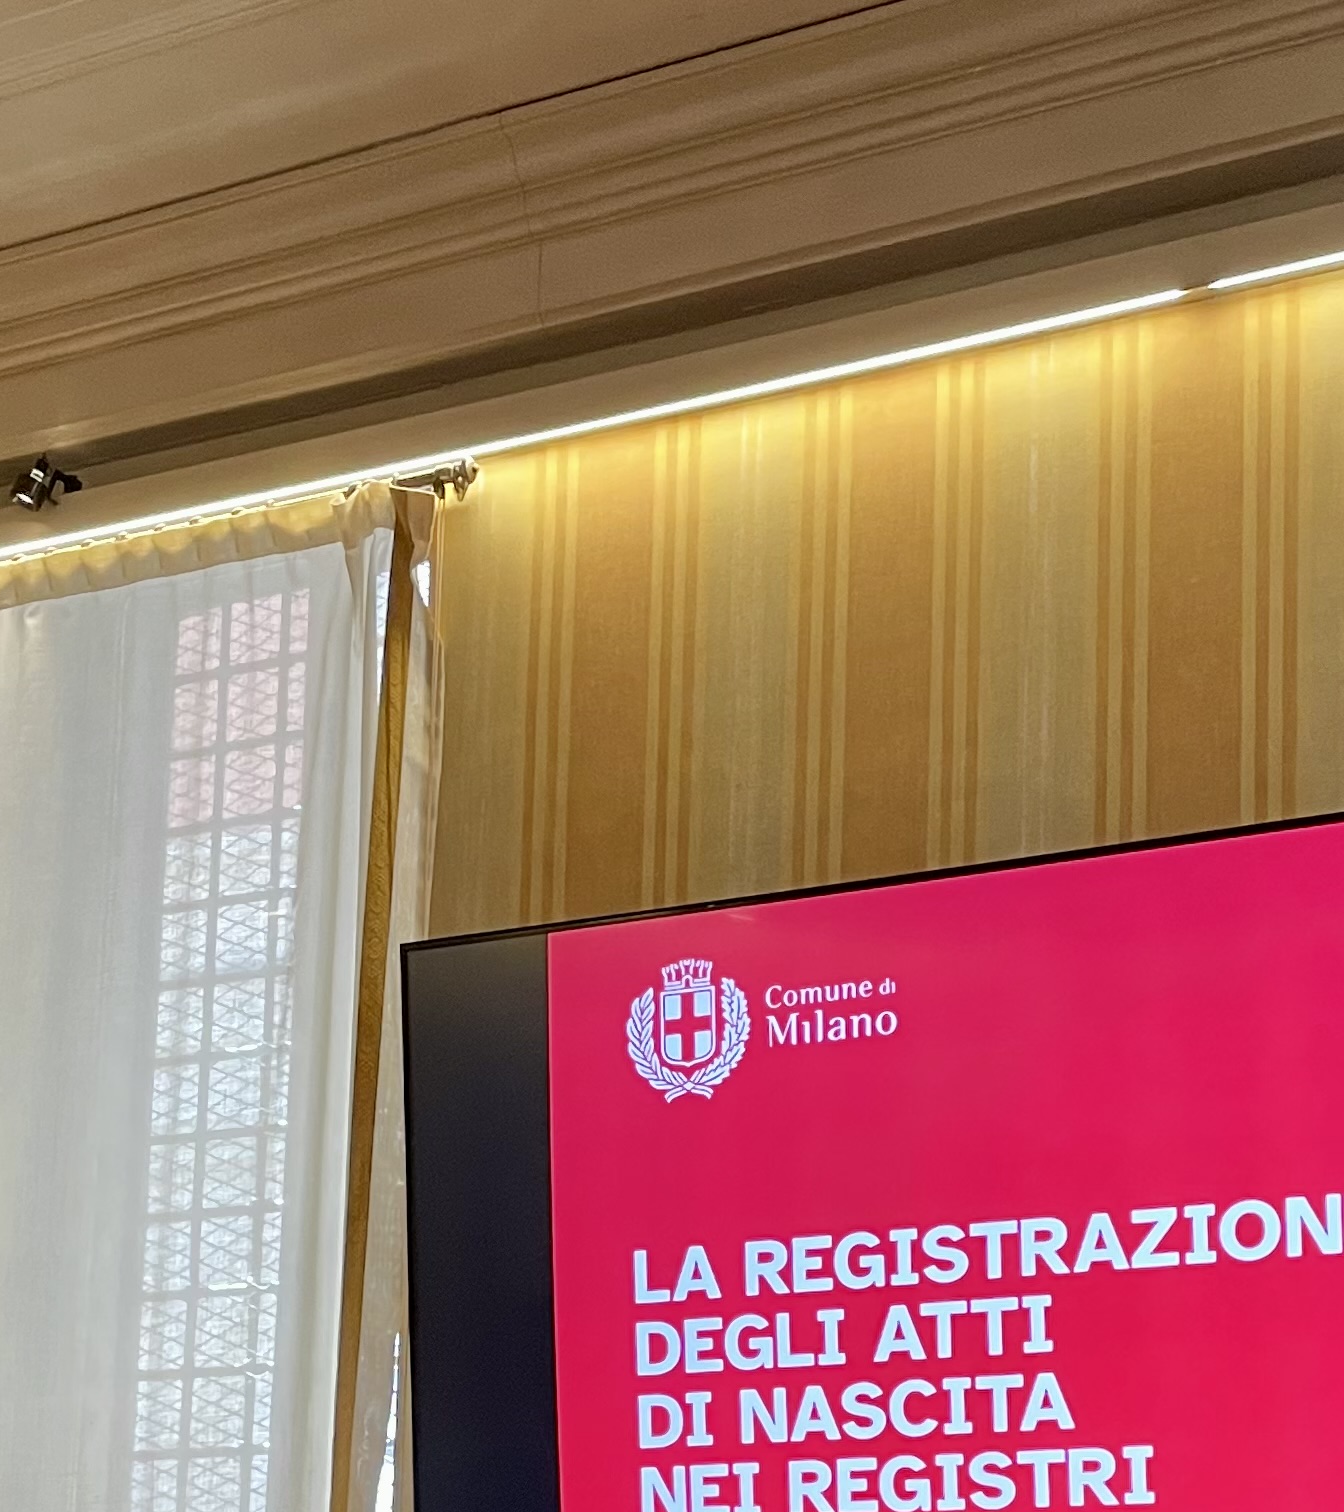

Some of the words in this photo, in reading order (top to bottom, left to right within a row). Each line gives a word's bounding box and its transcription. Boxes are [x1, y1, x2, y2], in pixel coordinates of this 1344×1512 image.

[765, 980, 873, 1009] Comune
[878, 977, 896, 995] di
[765, 1009, 898, 1048] Milano
[633, 1245, 722, 1304] LA
[634, 1308, 846, 1377] DEGLI
[873, 1295, 1054, 1363] ATTI
[637, 1391, 714, 1449] DI
[739, 1373, 1076, 1444] NASCITA
